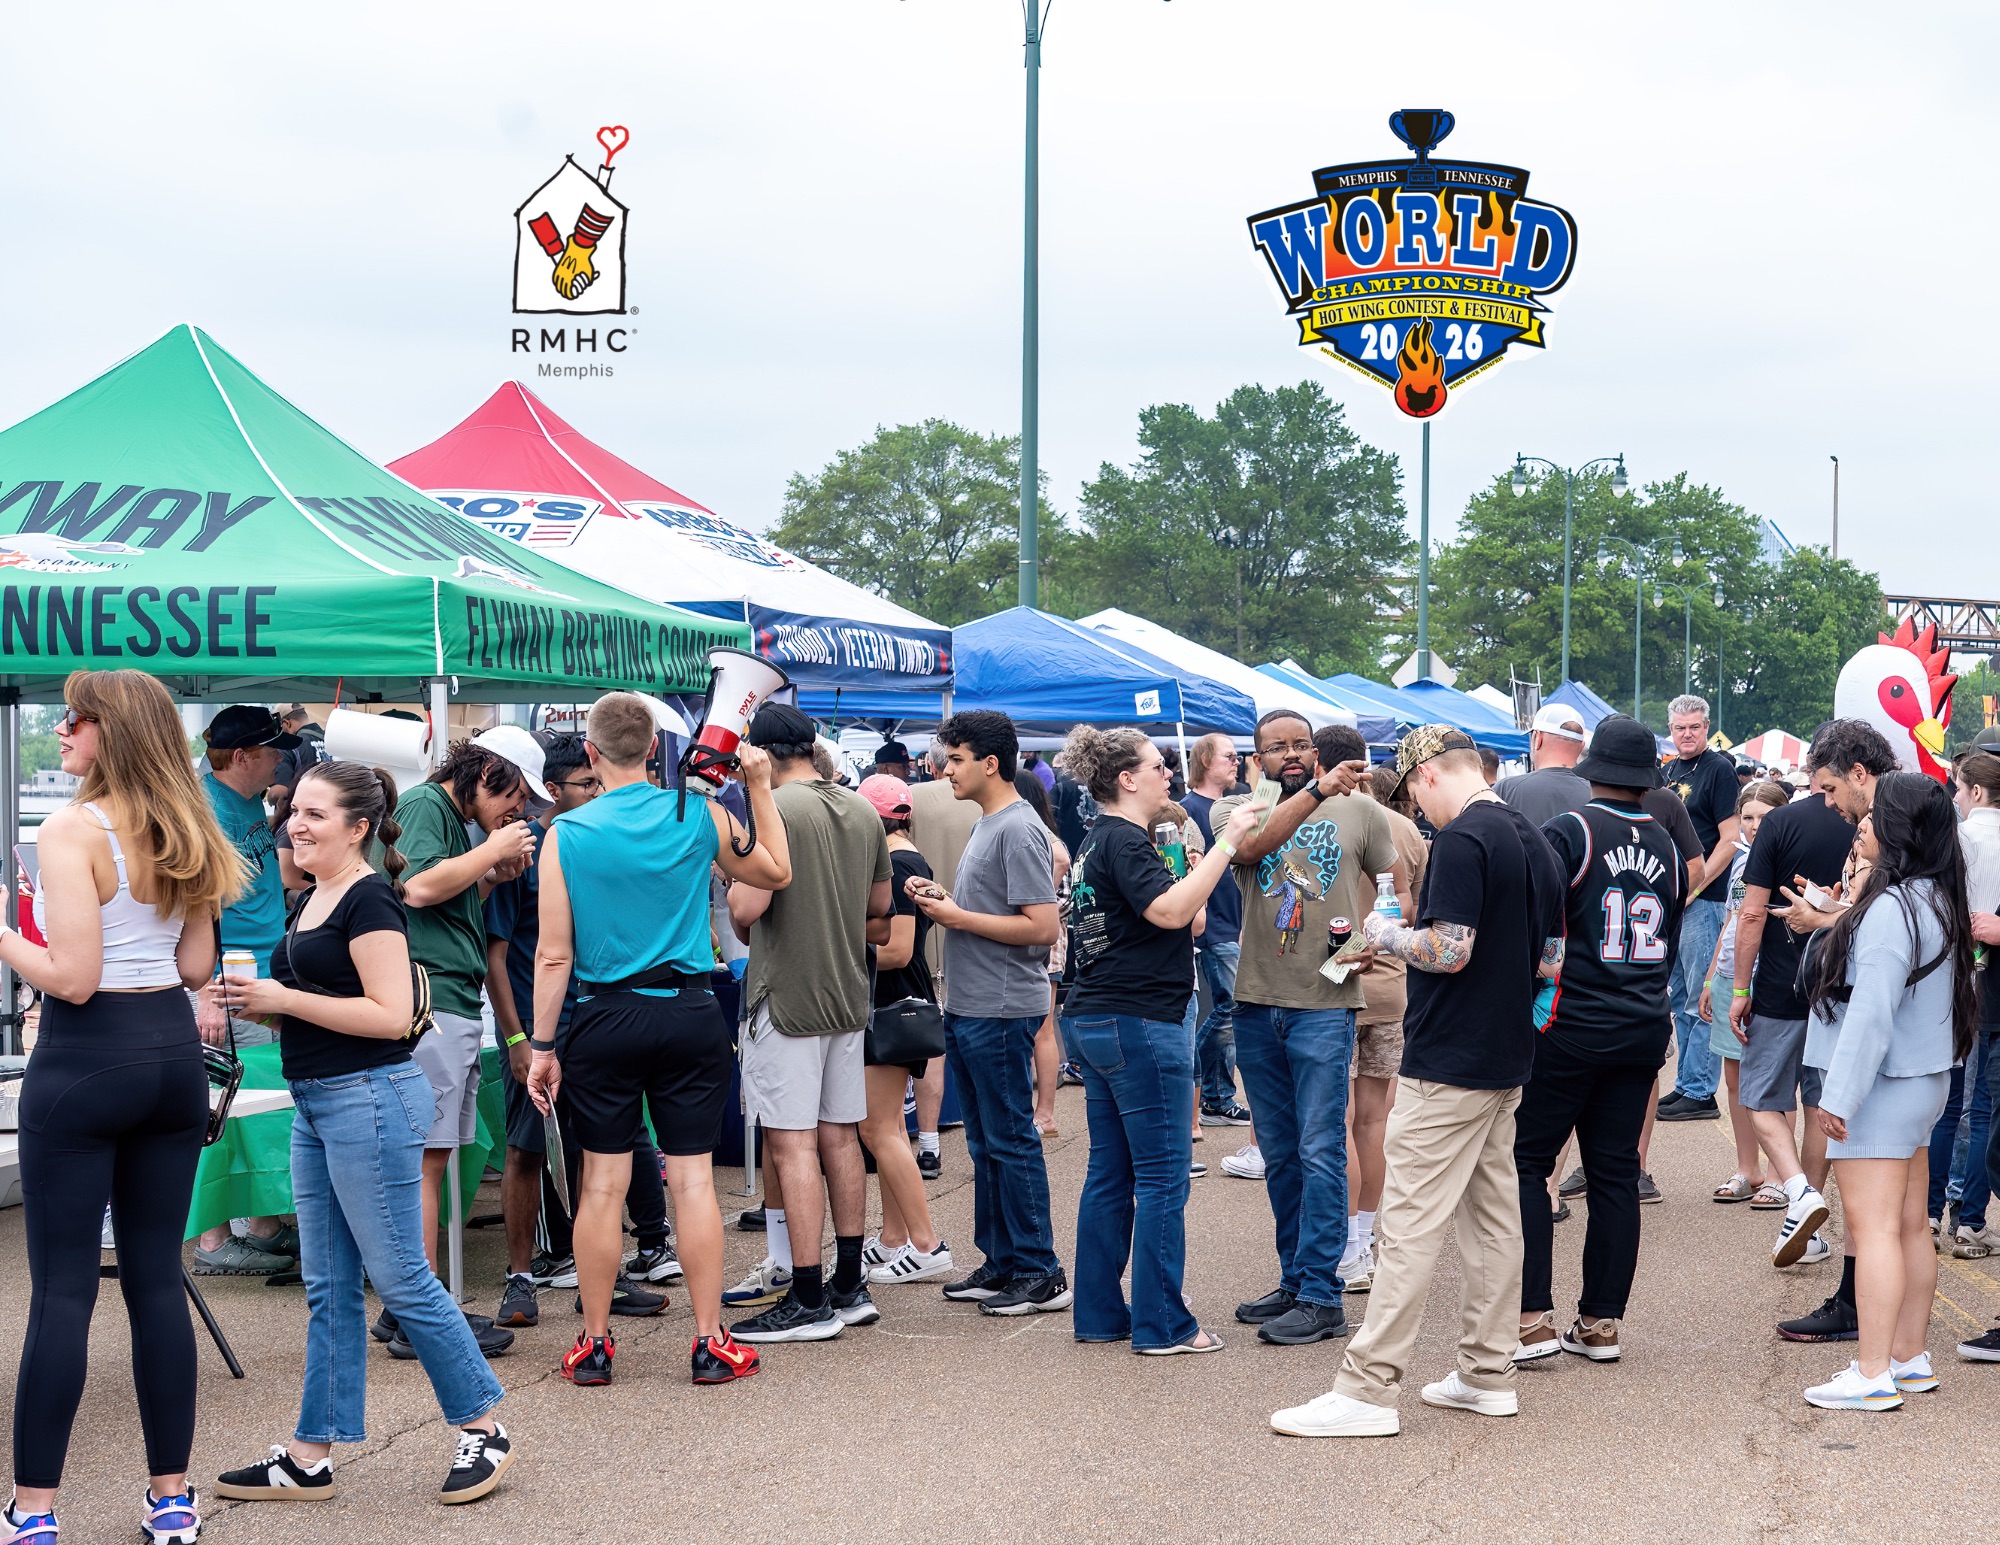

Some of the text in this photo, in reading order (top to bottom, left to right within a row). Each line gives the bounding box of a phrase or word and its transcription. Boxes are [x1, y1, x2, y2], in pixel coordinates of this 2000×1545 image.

[466, 595, 554, 674] FLYWAY
[561, 609, 656, 684] BREWING
[773, 624, 936, 676] PROUDLY VETERAN OWNED
[738, 690, 757, 717] PYLE
[1603, 844, 1666, 884] MORANT
[1599, 886, 1668, 964] 12
